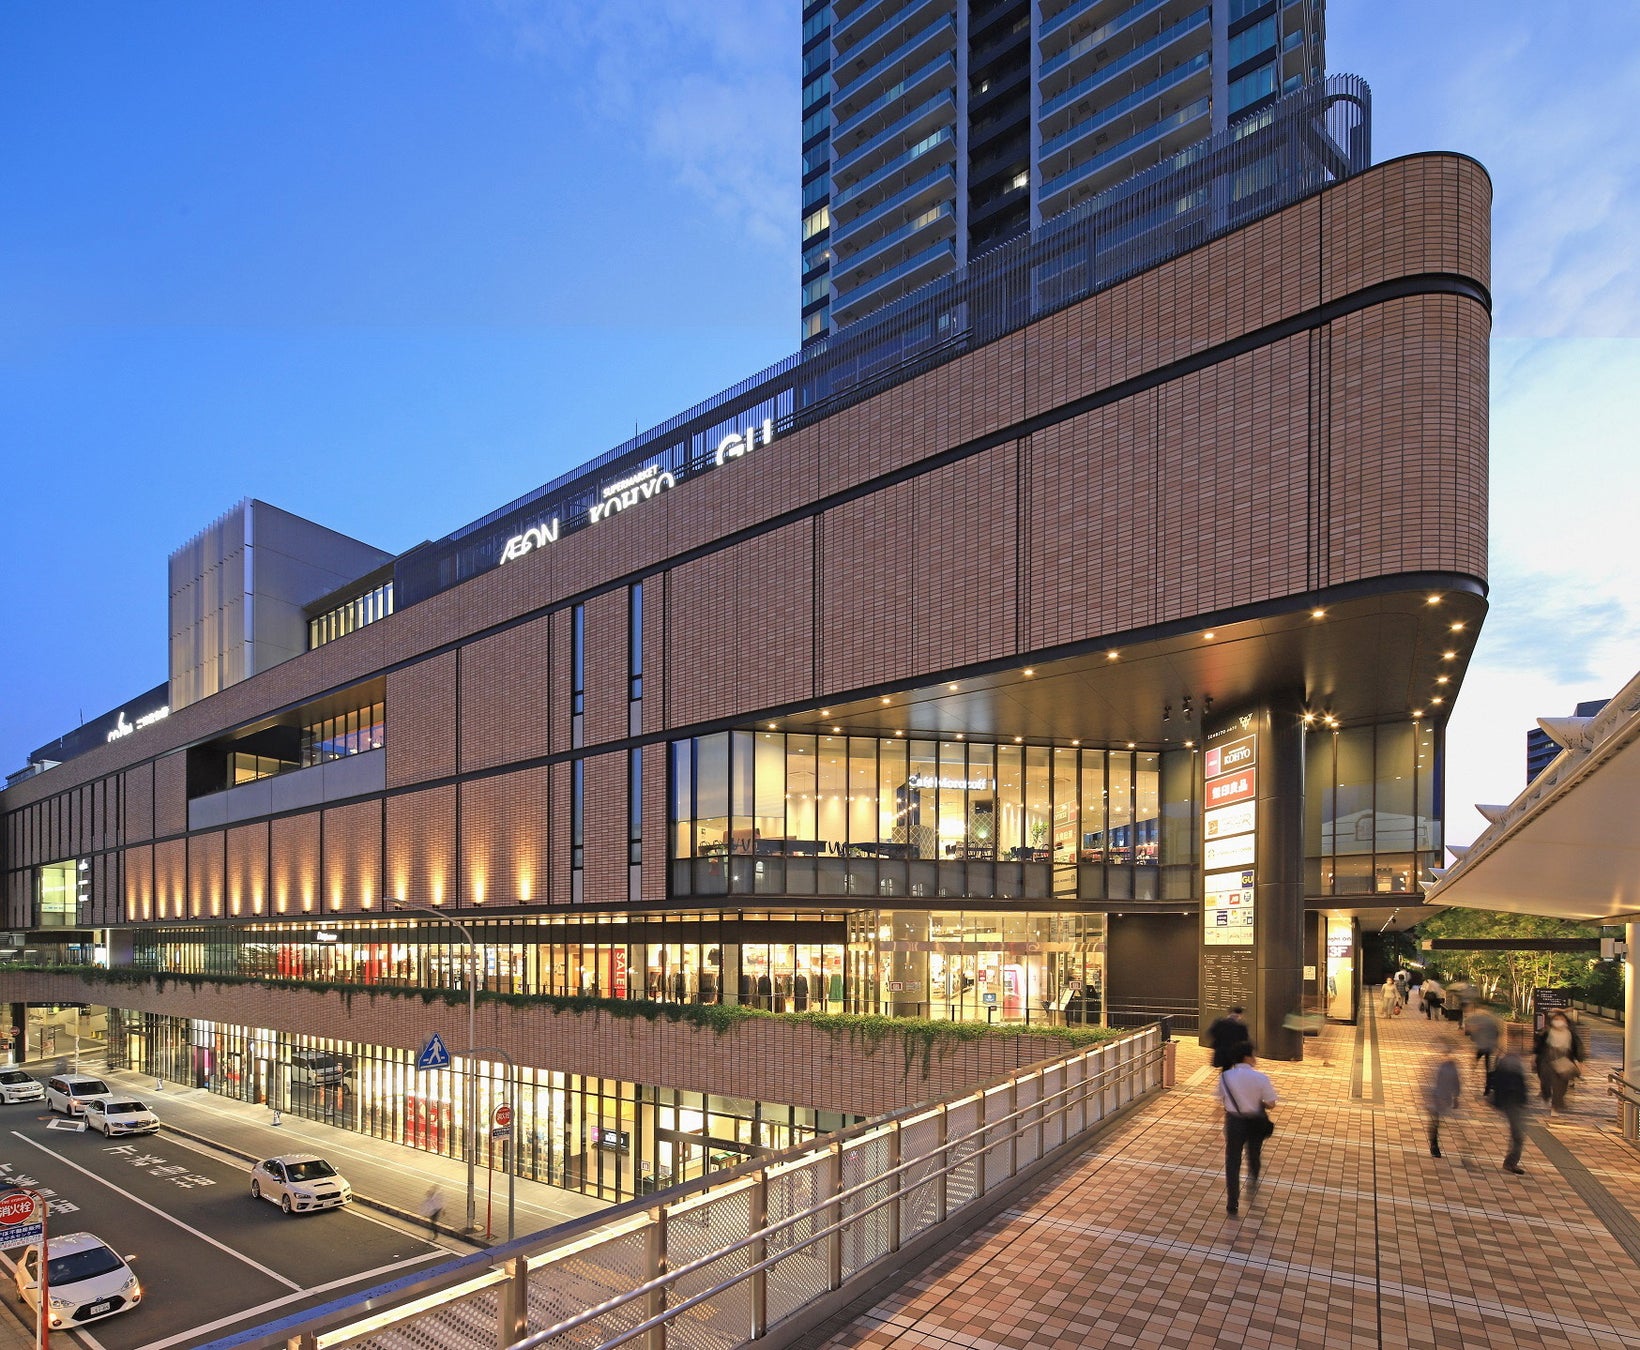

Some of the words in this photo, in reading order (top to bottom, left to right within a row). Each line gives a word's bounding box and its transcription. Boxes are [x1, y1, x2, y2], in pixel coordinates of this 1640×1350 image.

[603, 464, 659, 498] SUPERMARKET
[1224, 748, 1251, 765] KOHYO
[1242, 875, 1253, 884] GU
[616, 952, 625, 986] SALE
[0, 1201, 31, 1218] 消火栓
